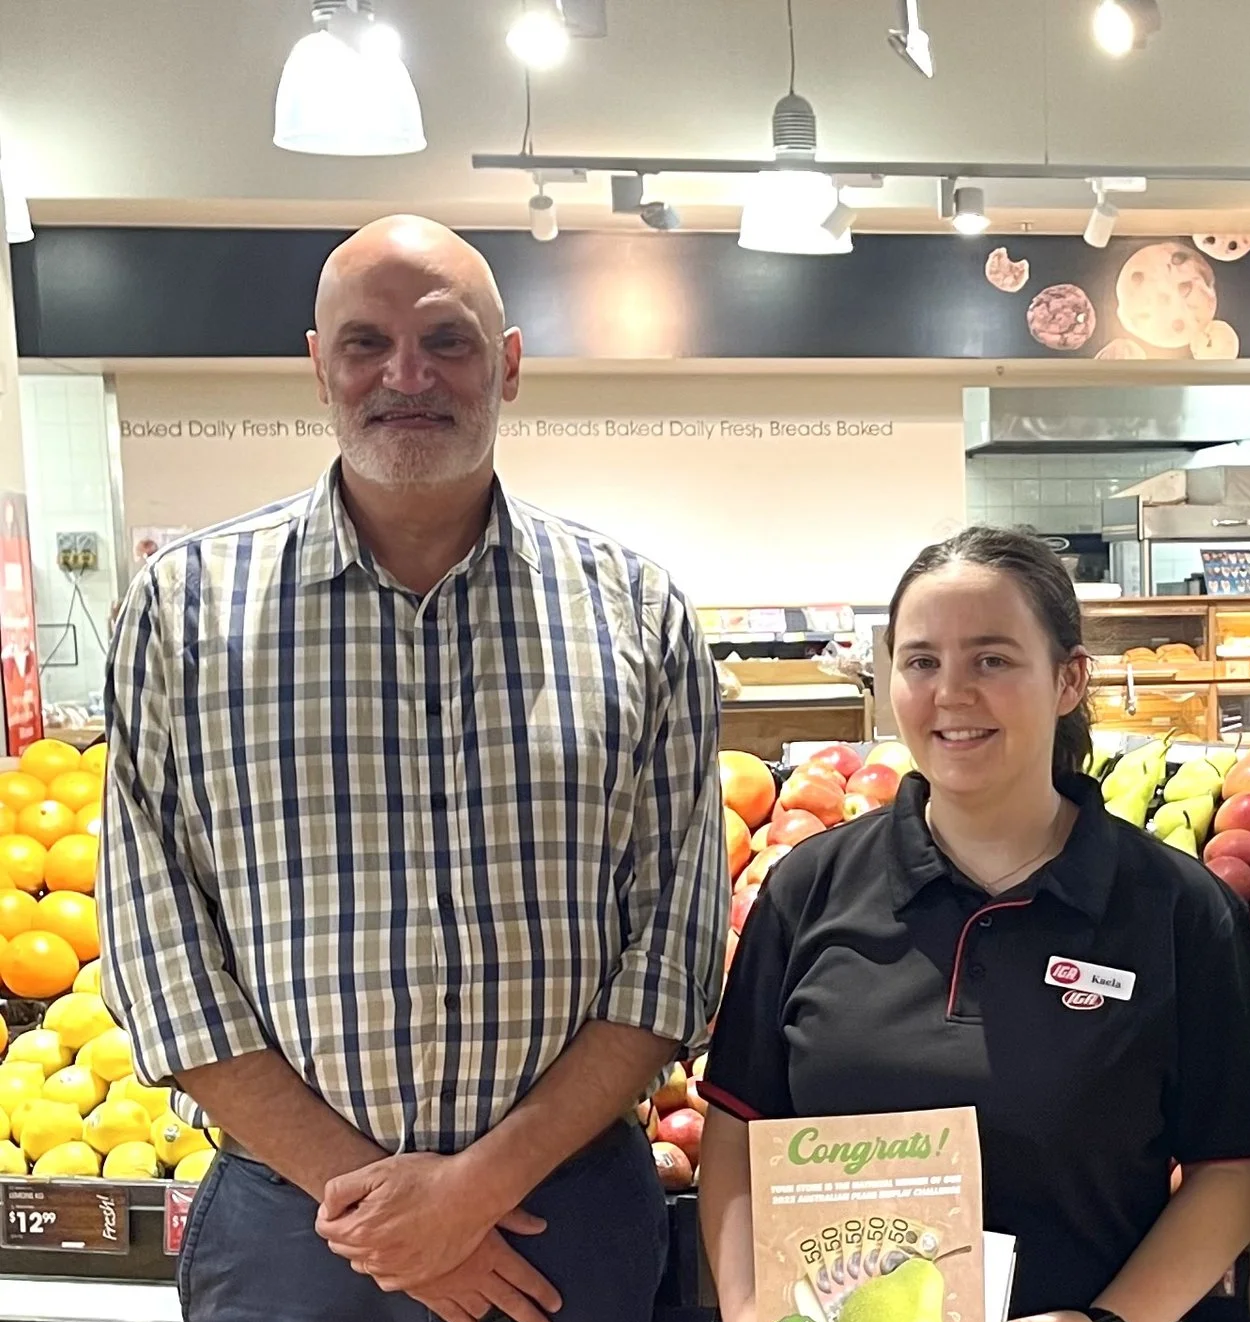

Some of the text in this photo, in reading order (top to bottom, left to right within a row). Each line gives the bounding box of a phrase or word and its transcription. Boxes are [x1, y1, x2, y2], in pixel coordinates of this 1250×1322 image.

[120, 419, 893, 441] Baked Daily Fresh Brea esh Breads Baked Daily Fresh Breads Baked
[1051, 964, 1079, 981] IGA
[1066, 992, 1100, 1006] IGA
[787, 1127, 951, 1175] Congrats!
[96, 1194, 118, 1241] Fresh!
[867, 1216, 885, 1241] 50
[821, 1227, 842, 1252] 50
[844, 1220, 863, 1244] 50
[888, 1218, 909, 1244] 50
[800, 1239, 822, 1264] 50
